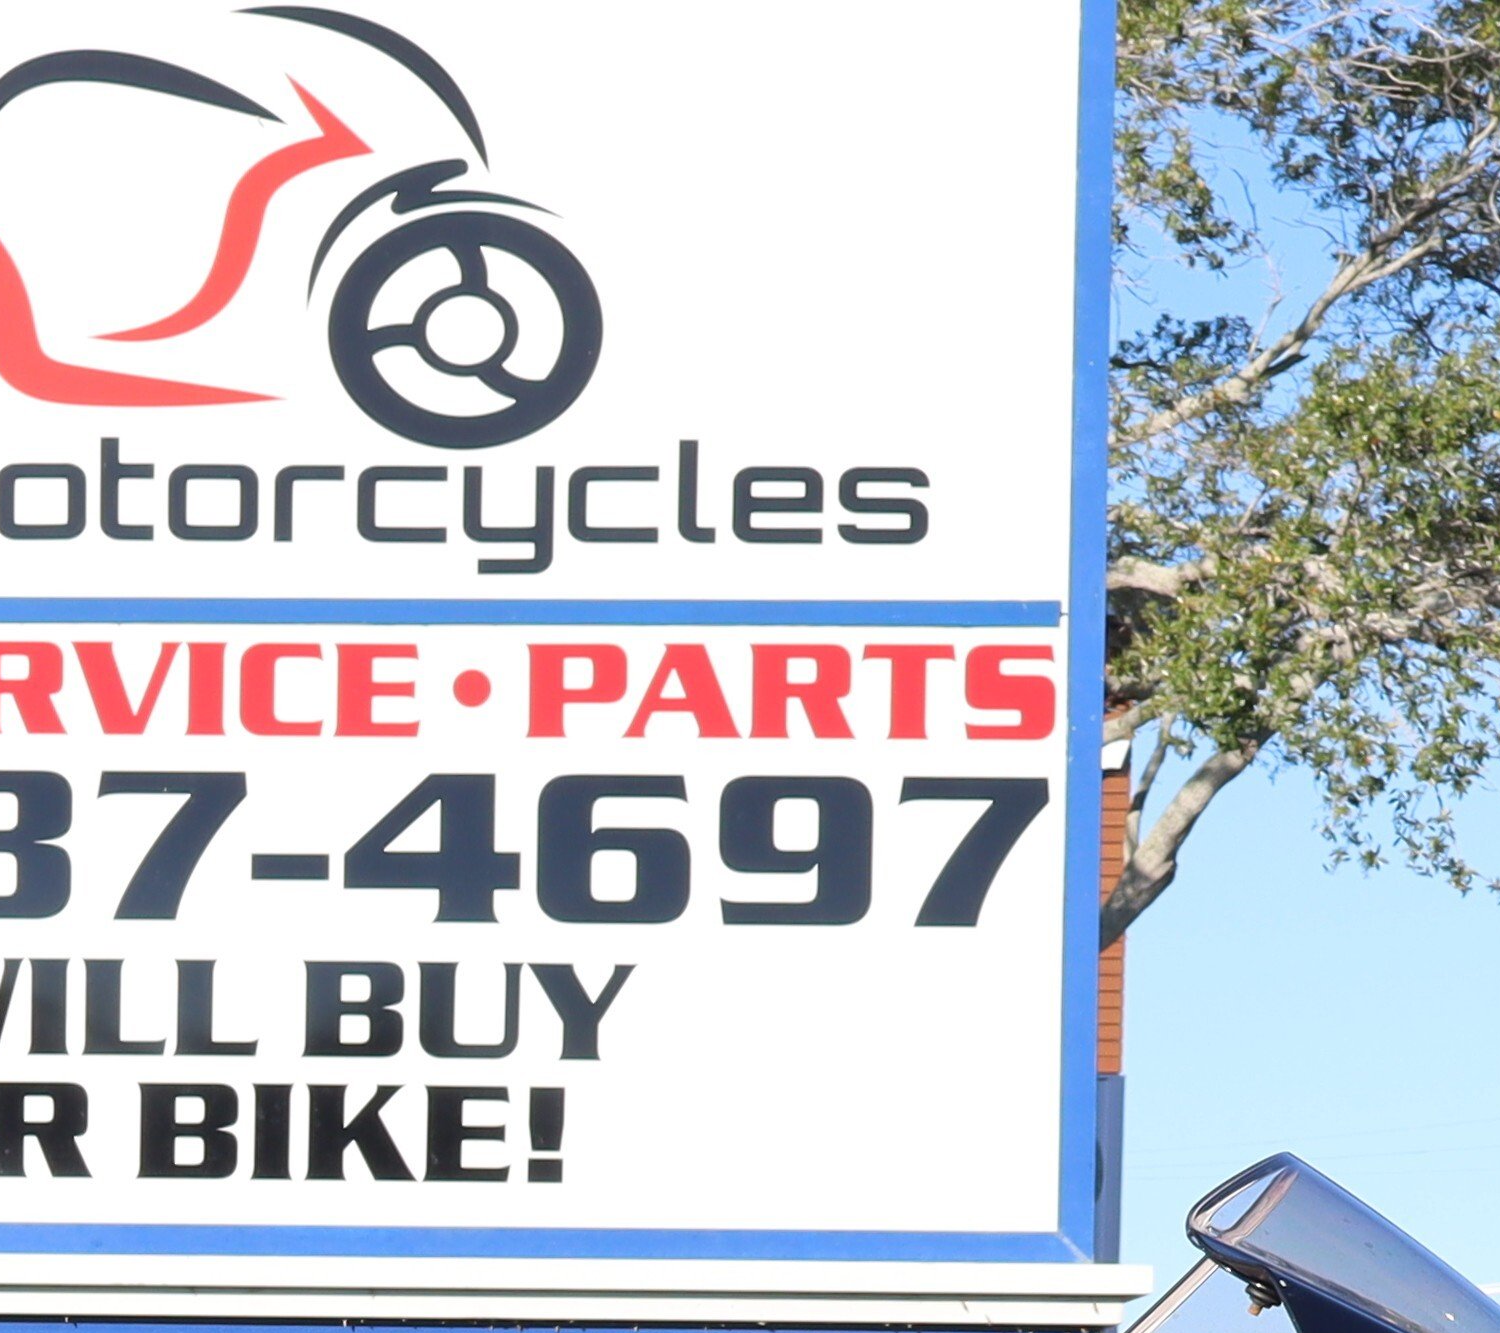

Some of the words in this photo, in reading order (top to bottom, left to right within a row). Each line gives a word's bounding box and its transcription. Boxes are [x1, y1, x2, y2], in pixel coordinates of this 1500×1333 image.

[527, 643, 1057, 741] PARTS
[302, 960, 636, 1061] BUY
[137, 1082, 565, 1183] BIKE!
